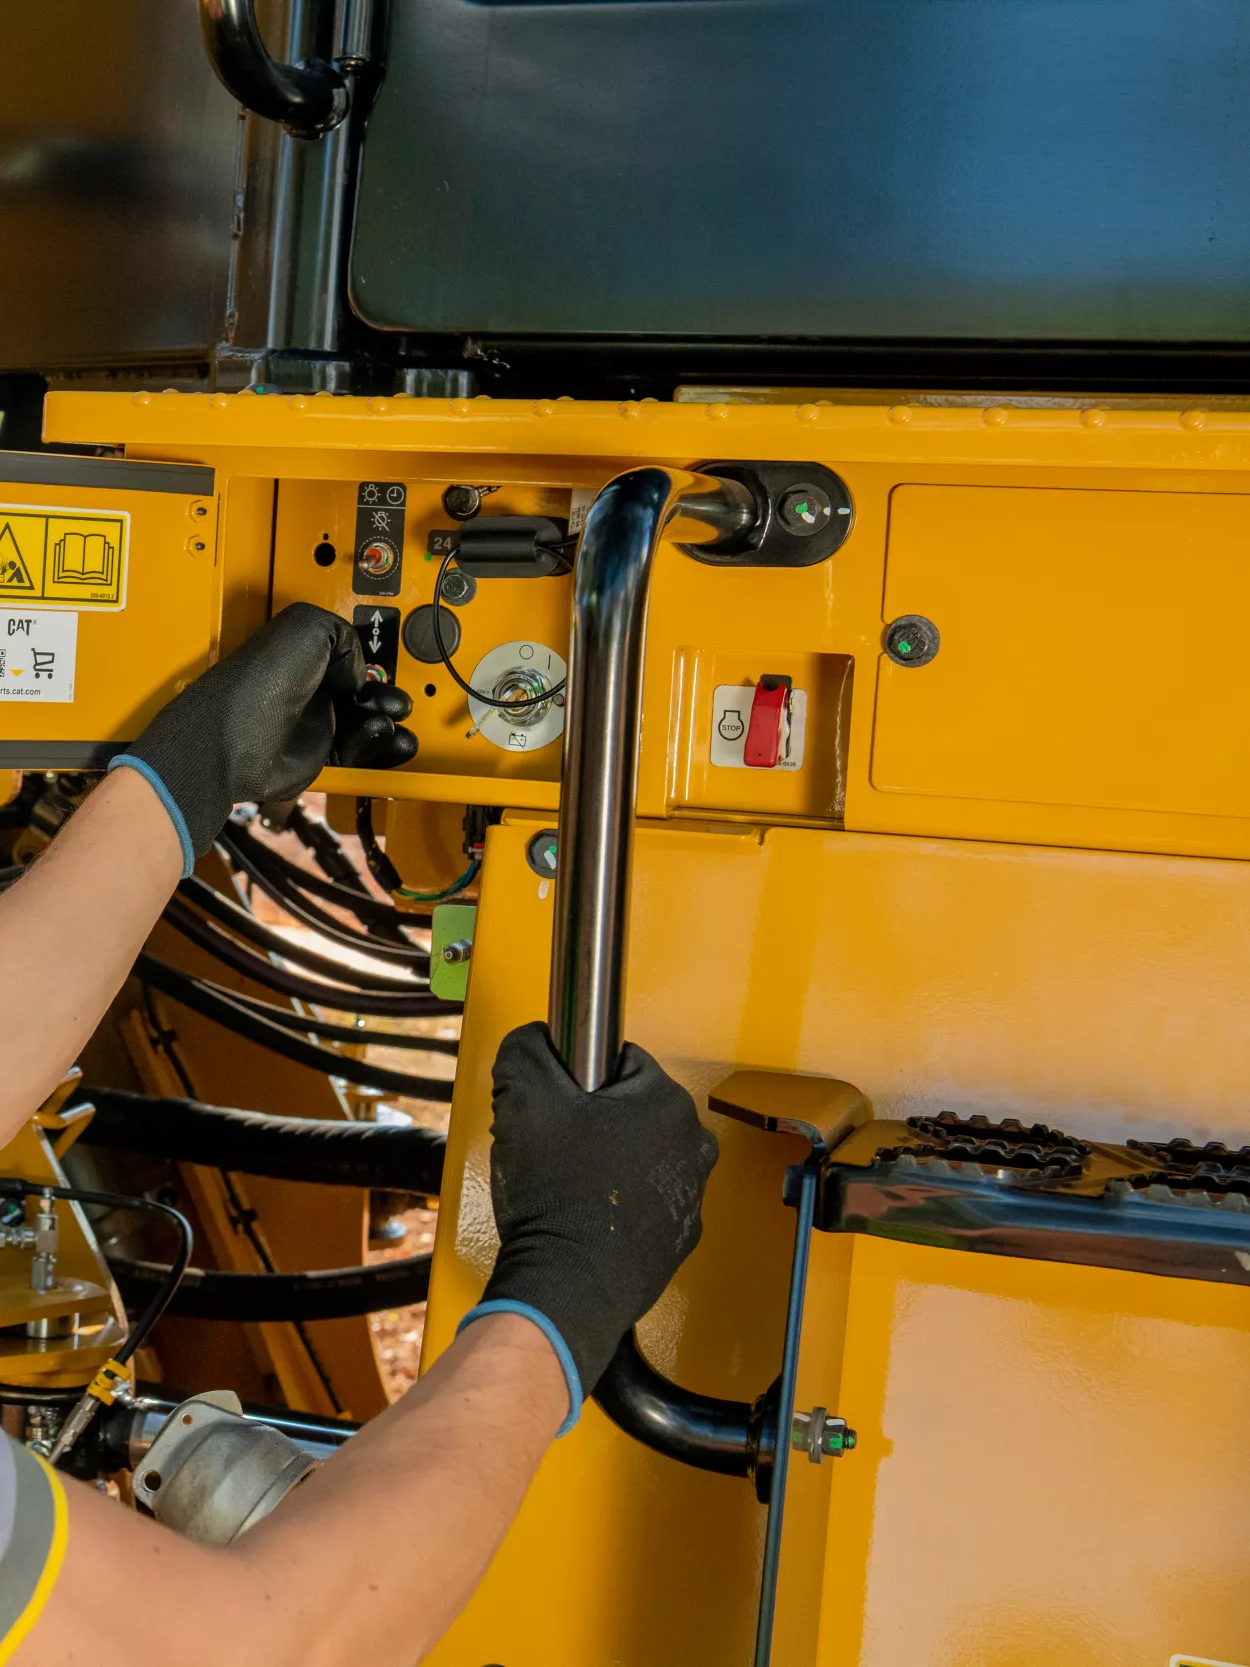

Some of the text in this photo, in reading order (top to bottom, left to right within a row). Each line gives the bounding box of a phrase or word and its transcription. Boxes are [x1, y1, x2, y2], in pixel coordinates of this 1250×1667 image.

[433, 536, 453, 550] 24
[7, 618, 33, 637] CAT
[721, 724, 742, 732] STOP
